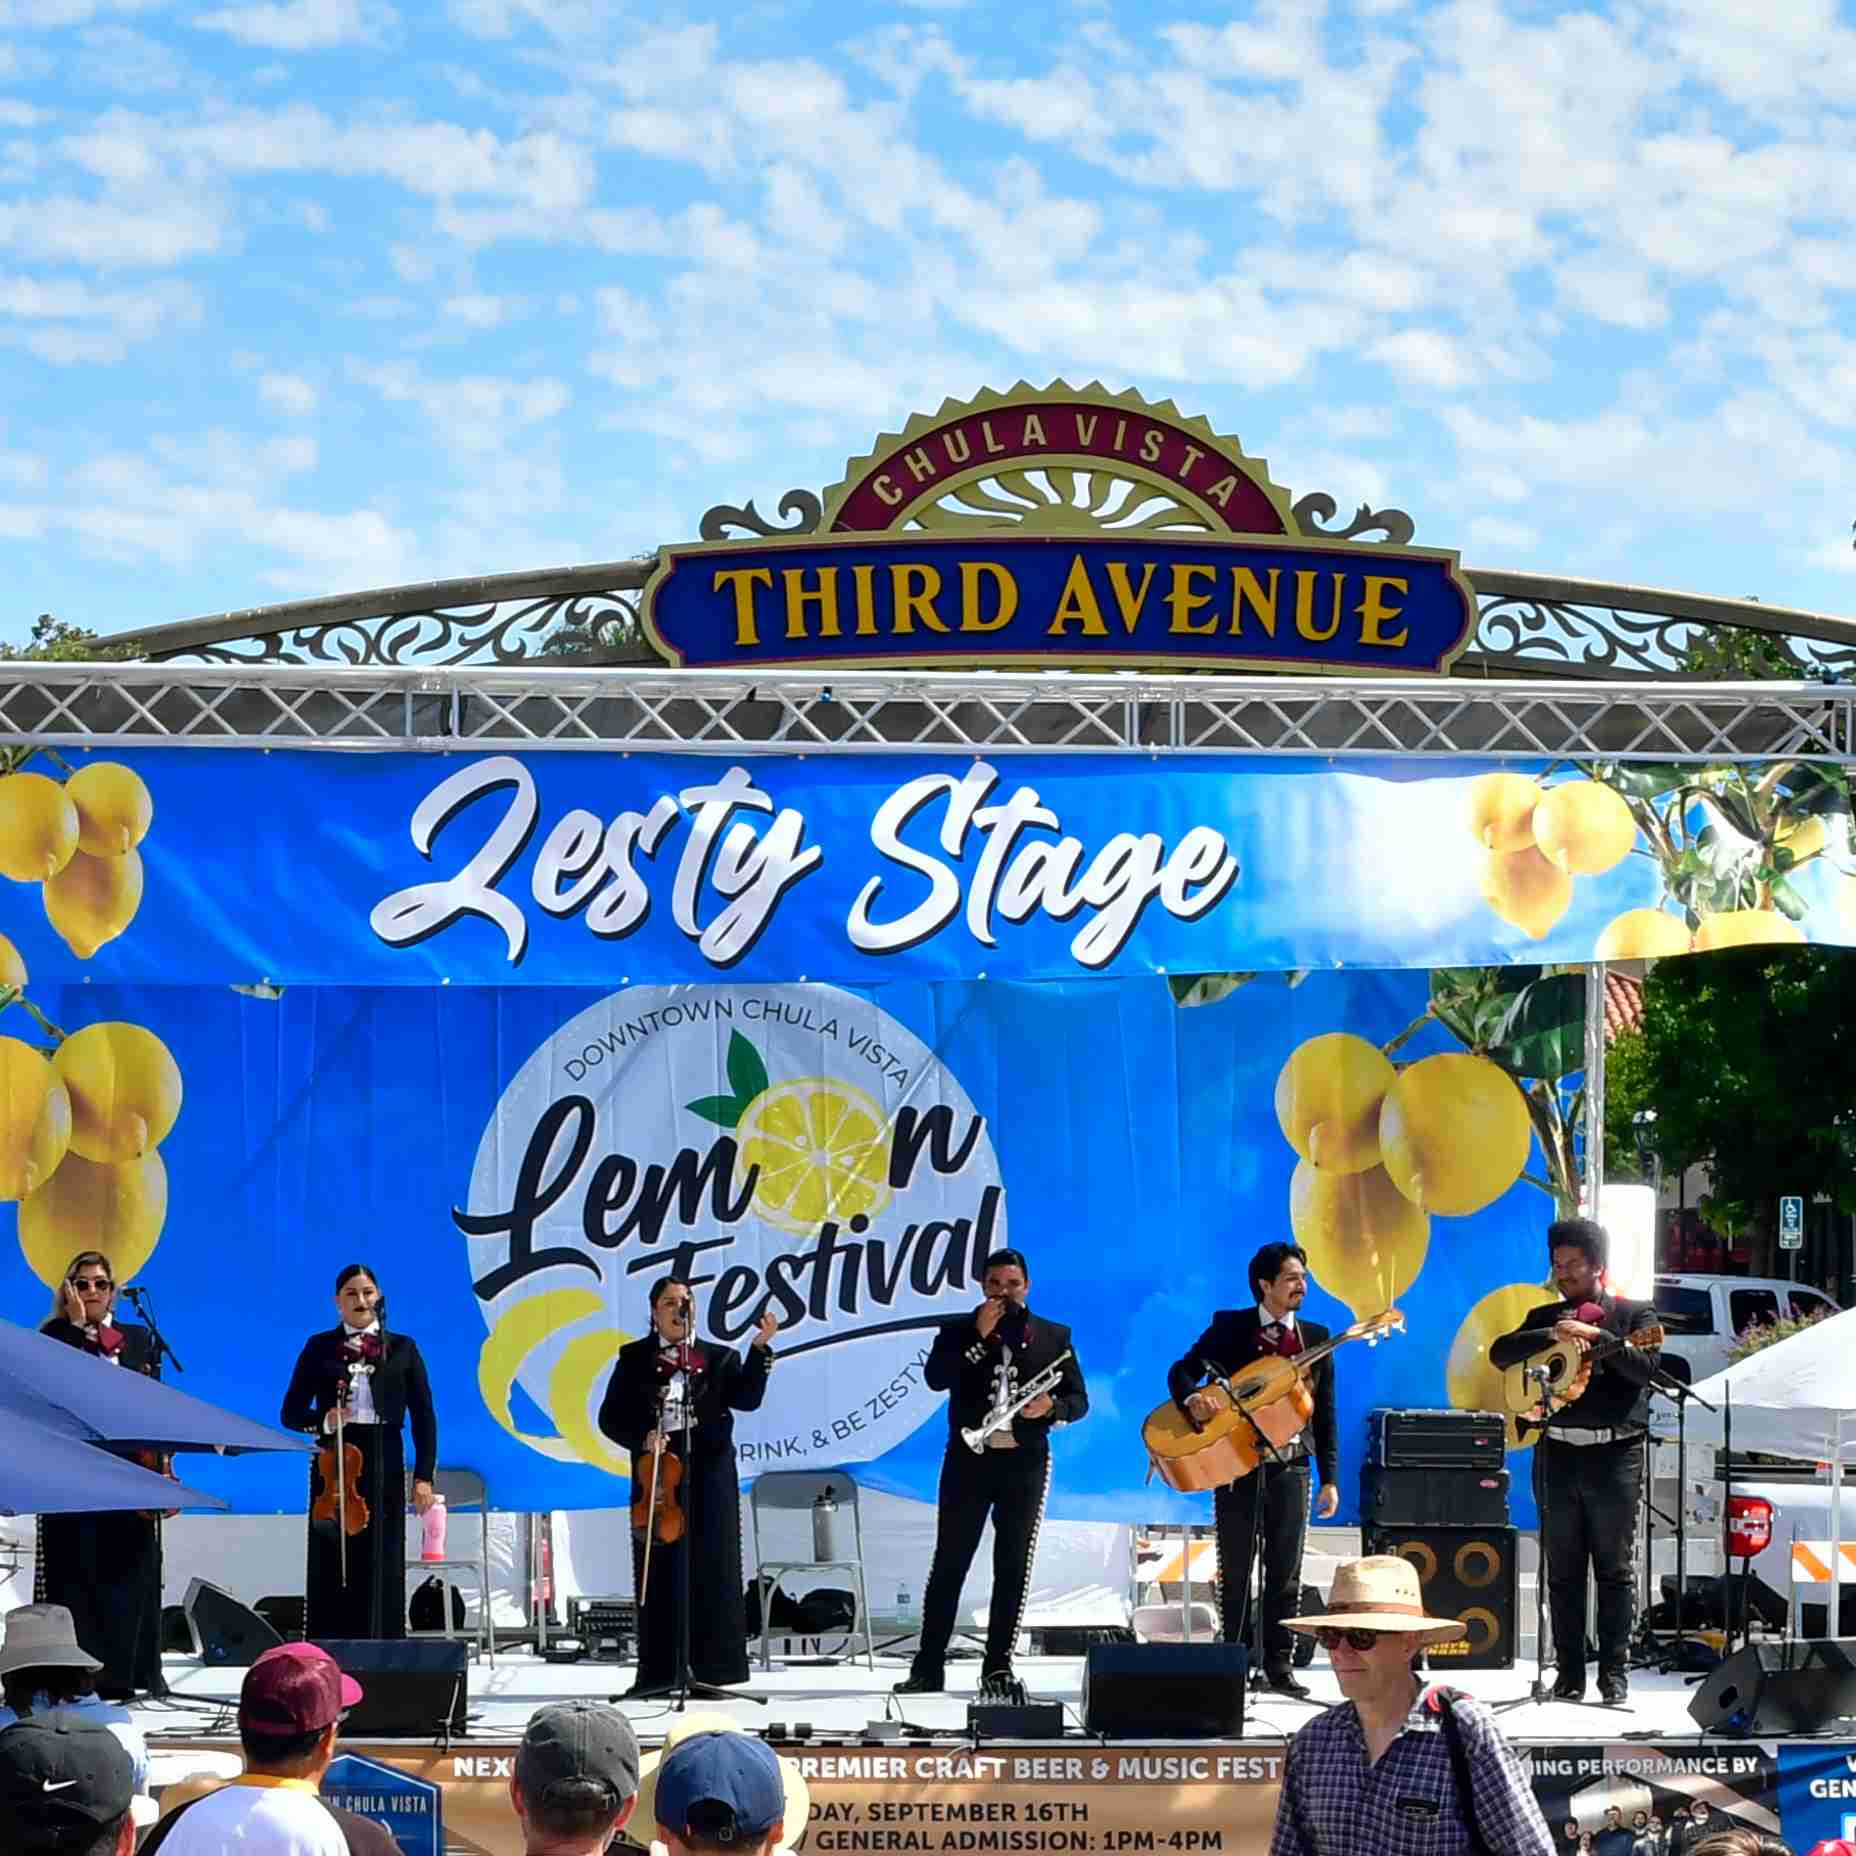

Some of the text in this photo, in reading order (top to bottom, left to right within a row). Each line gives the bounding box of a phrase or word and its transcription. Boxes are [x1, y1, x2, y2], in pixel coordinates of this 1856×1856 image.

[872, 413, 1239, 509] CHULA VISTA
[713, 554, 1411, 649] THIRD AVENUE
[370, 755, 1237, 968] Zesty Stage
[563, 998, 910, 1089] DOWNTOWN CHULA VISTA
[626, 1186, 1002, 1343] Festival
[738, 1436, 808, 1463] RINK,
[812, 1429, 830, 1449] &
[831, 1410, 867, 1441] BE
[453, 1756, 514, 1777] NEX
[915, 1756, 1008, 1779] CRAFT
[1013, 1757, 1083, 1779] BEER
[1090, 1757, 1109, 1779] &
[1117, 1757, 1209, 1779] MUSIC
[1217, 1757, 1282, 1778] FEST
[1577, 1757, 1728, 1777] PERFORMANCE
[1732, 1756, 1759, 1774] BY
[346, 1796, 385, 1813] CHULA
[391, 1796, 427, 1813] VISTA
[868, 1803, 1016, 1821] SEPTEMBER
[1025, 1803, 1089, 1821] 16TH
[816, 1831, 934, 1850] GENERAL
[942, 1831, 1095, 1850] ADMISSION:
[1103, 1830, 1223, 1850] 1PM-4PM
